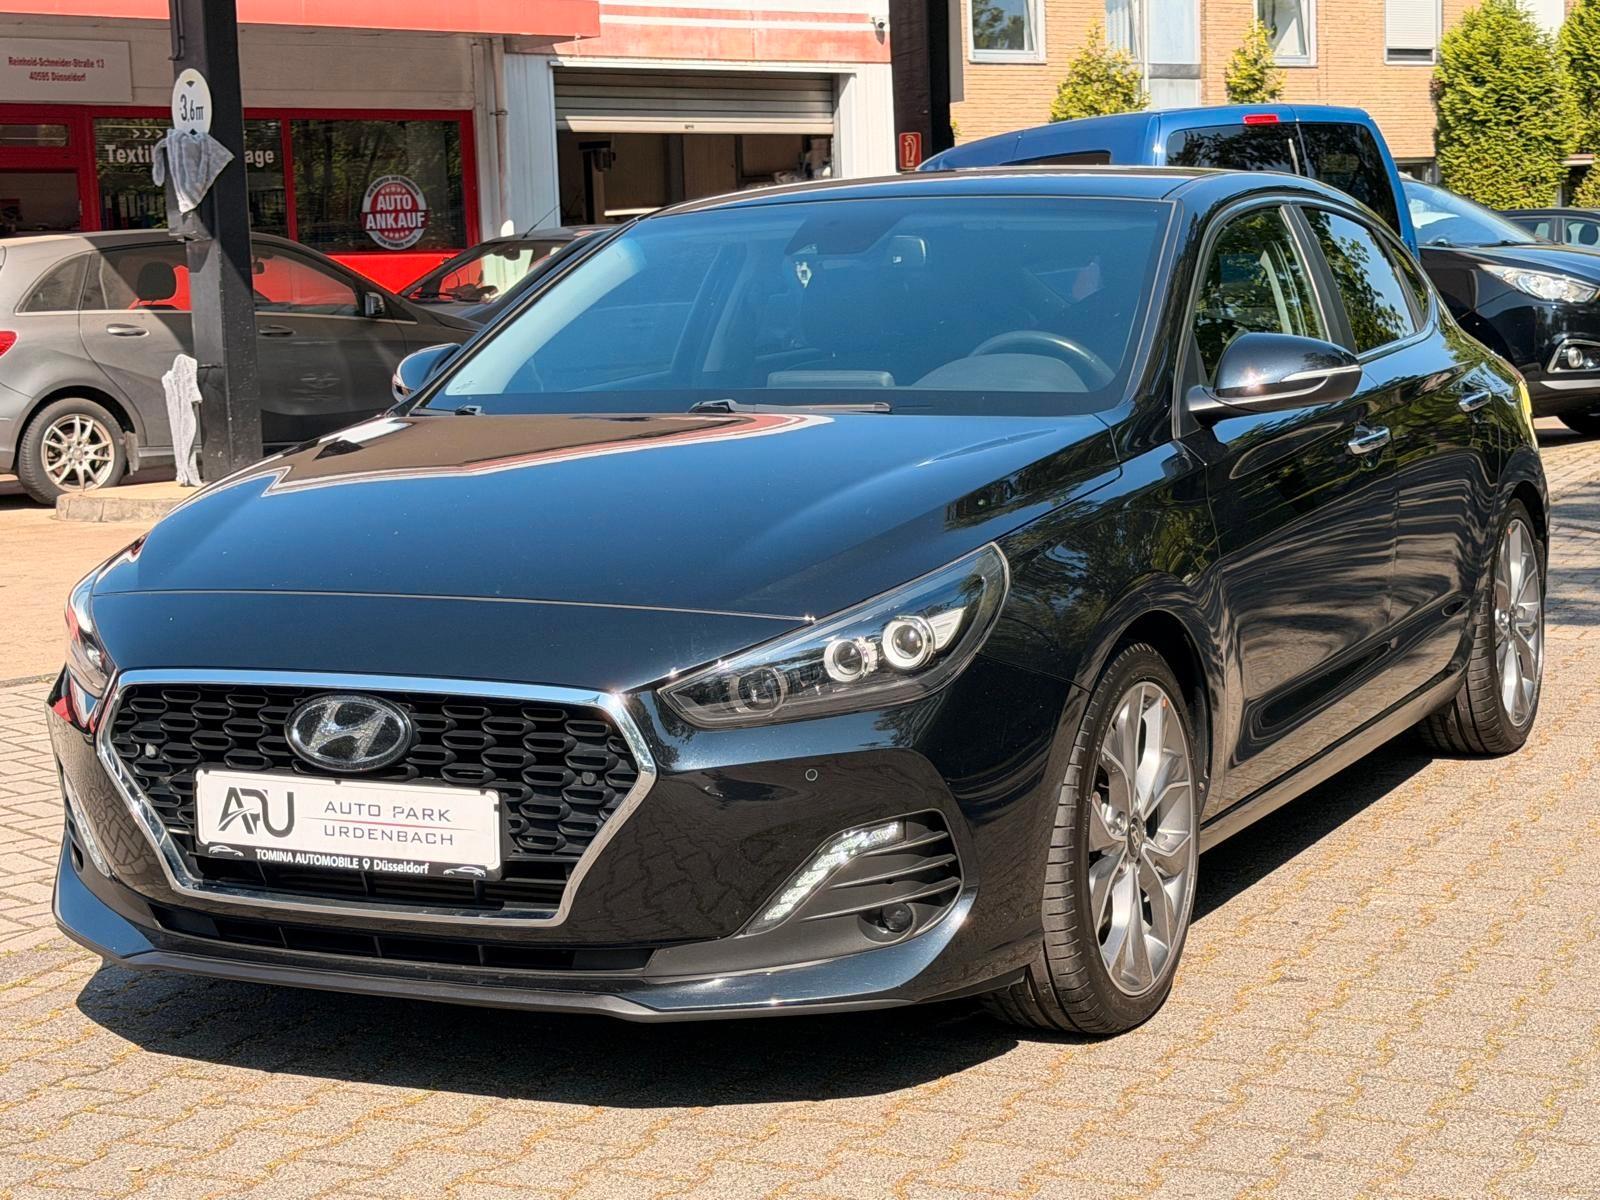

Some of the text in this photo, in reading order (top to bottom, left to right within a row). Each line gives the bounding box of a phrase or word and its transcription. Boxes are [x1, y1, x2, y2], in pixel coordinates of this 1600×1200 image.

[51, 71, 87, 82] Düsseldorf
[244, 150, 275, 168] age
[376, 194, 413, 211] AUTO
[365, 212, 425, 230] ANKAUF
[324, 800, 452, 823] AUTO PARK
[323, 824, 454, 846] URDENBACH
[255, 848, 430, 875] TOMINA AUTOMOBILE Düsseldorf
